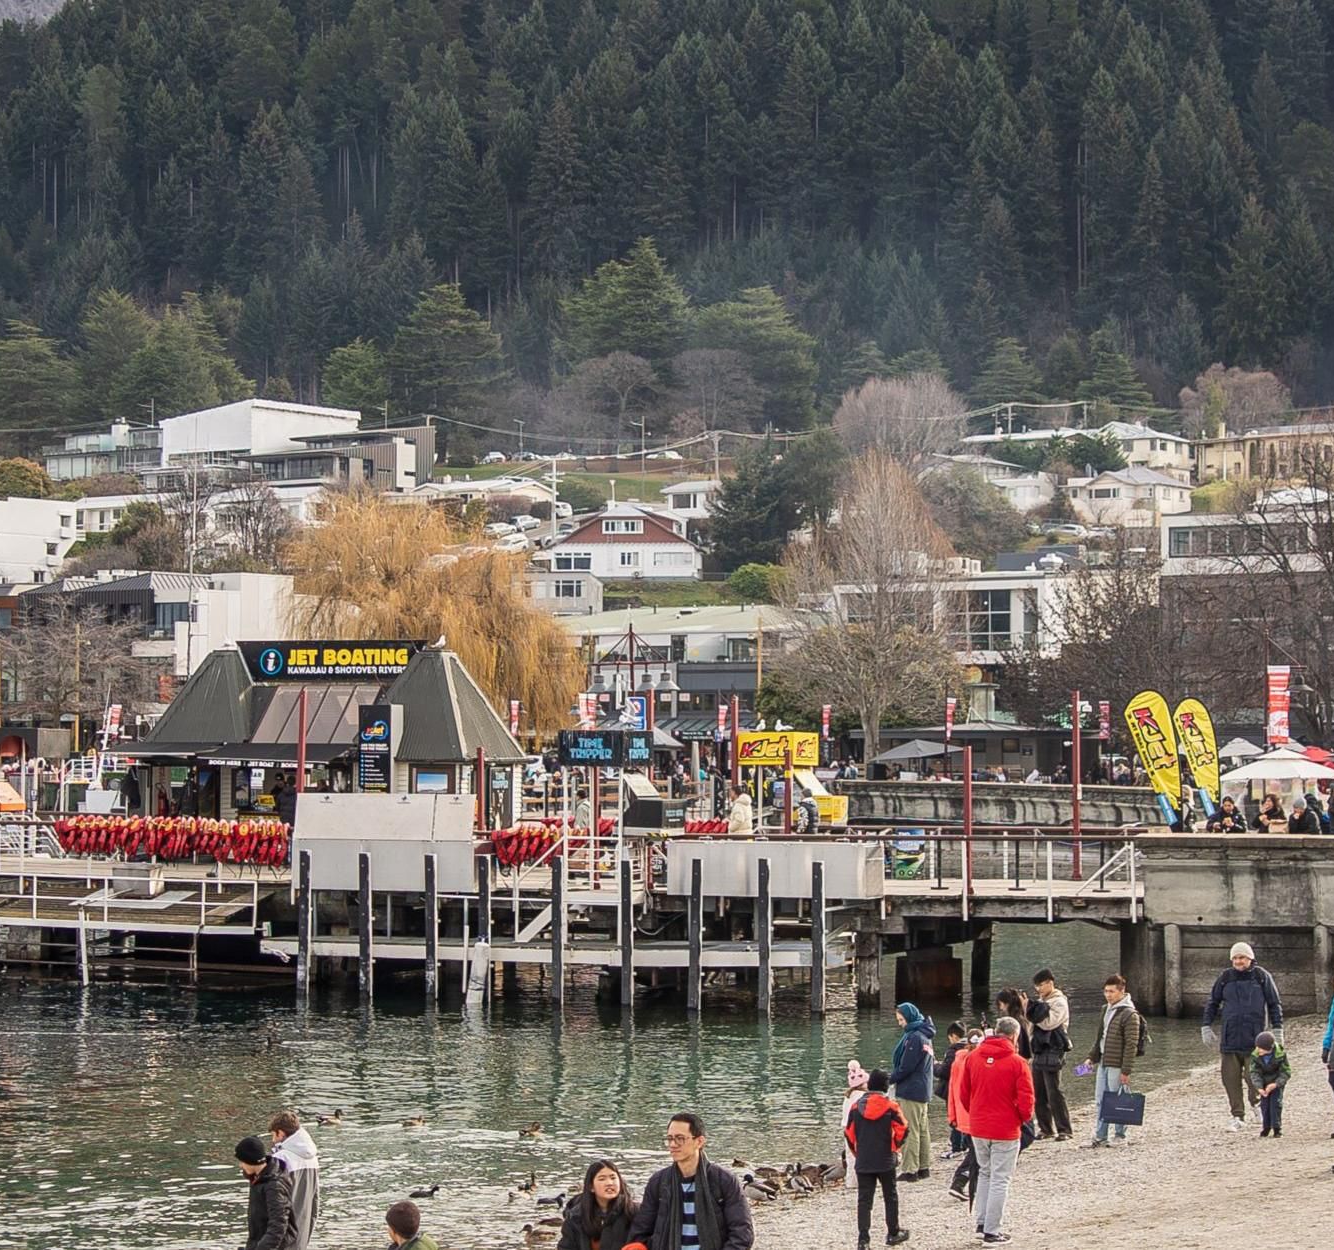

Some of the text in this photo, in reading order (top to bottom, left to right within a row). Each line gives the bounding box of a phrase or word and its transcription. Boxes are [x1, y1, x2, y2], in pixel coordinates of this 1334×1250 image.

[287, 649, 317, 665] JET
[323, 648, 408, 665] BOATING
[578, 738, 603, 748] TIME
[740, 736, 789, 758] KJet
[1132, 707, 1177, 770] KJet
[570, 749, 613, 760] TRIPPER
